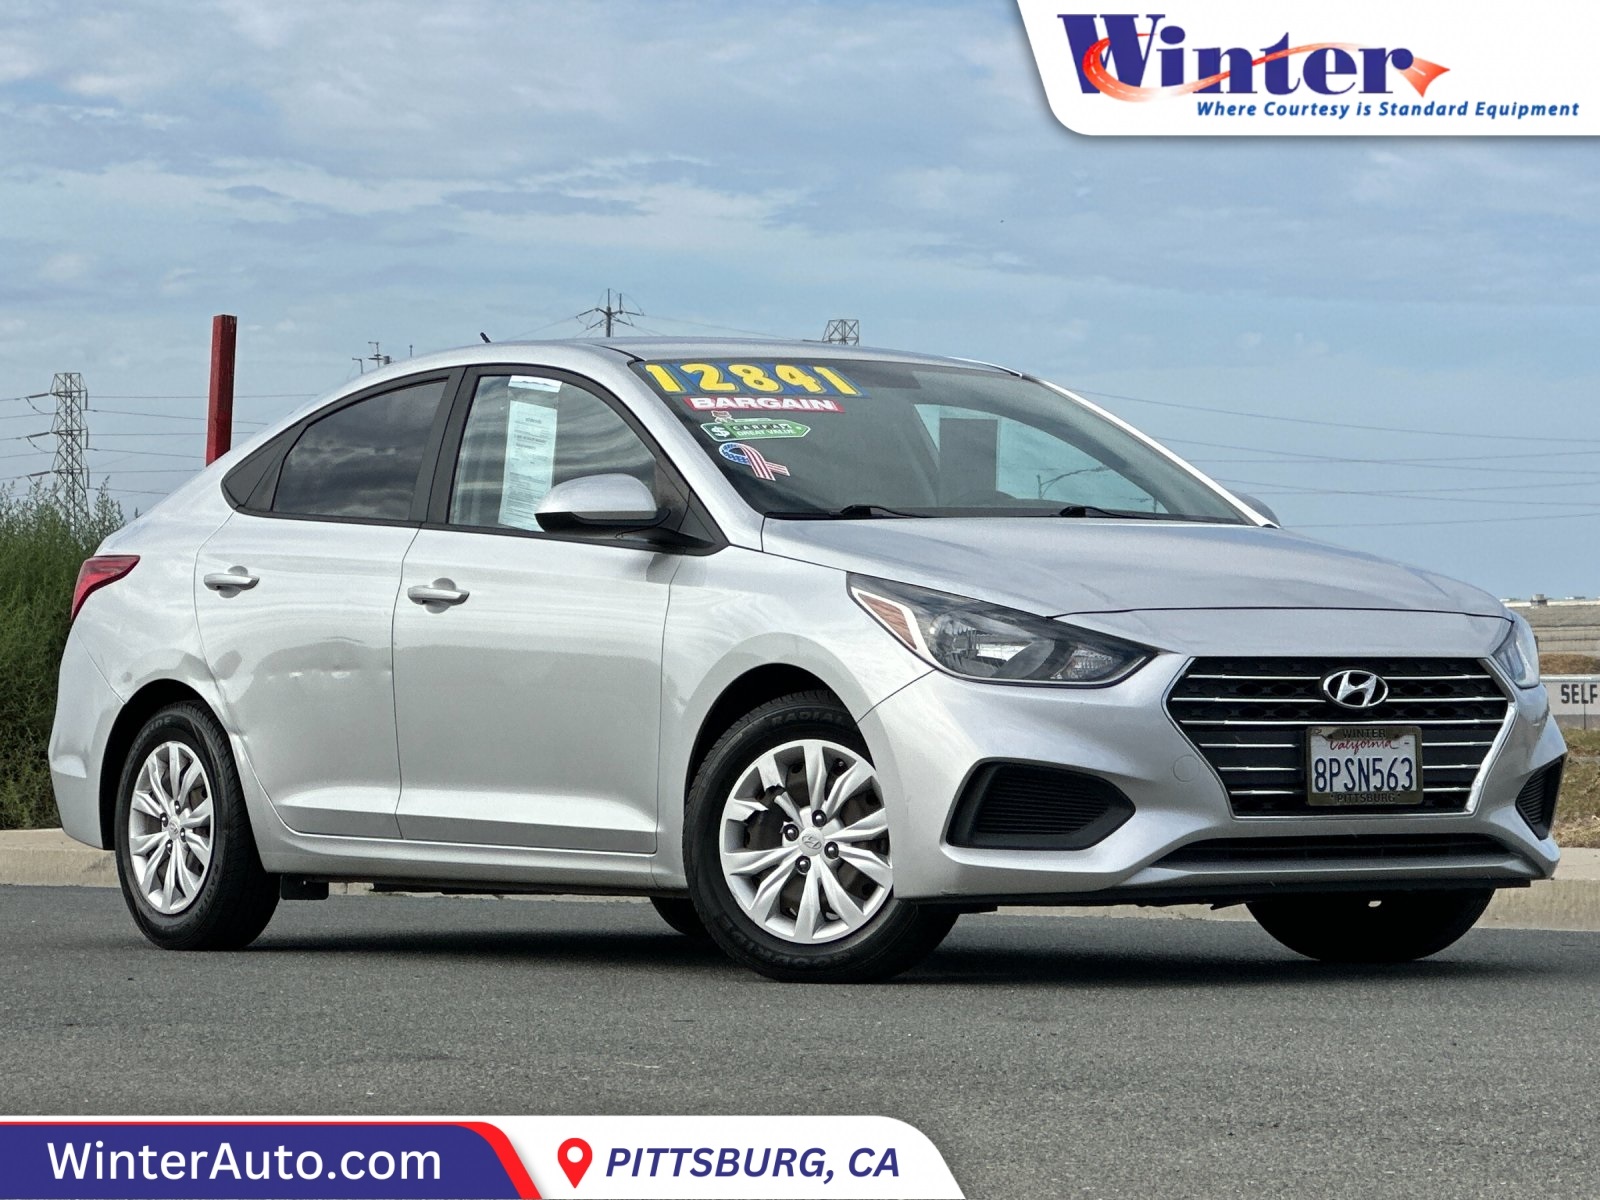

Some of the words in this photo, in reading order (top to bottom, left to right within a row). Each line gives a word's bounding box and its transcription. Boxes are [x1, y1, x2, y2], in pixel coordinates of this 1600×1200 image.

[645, 363, 862, 395] 12841
[691, 397, 837, 411] BARGAIN
[1560, 684, 1598, 704] SELF
[1342, 728, 1386, 739] WINTER
[1314, 757, 1413, 792] 8PSN563
[1336, 792, 1395, 804] PITTSBURG
